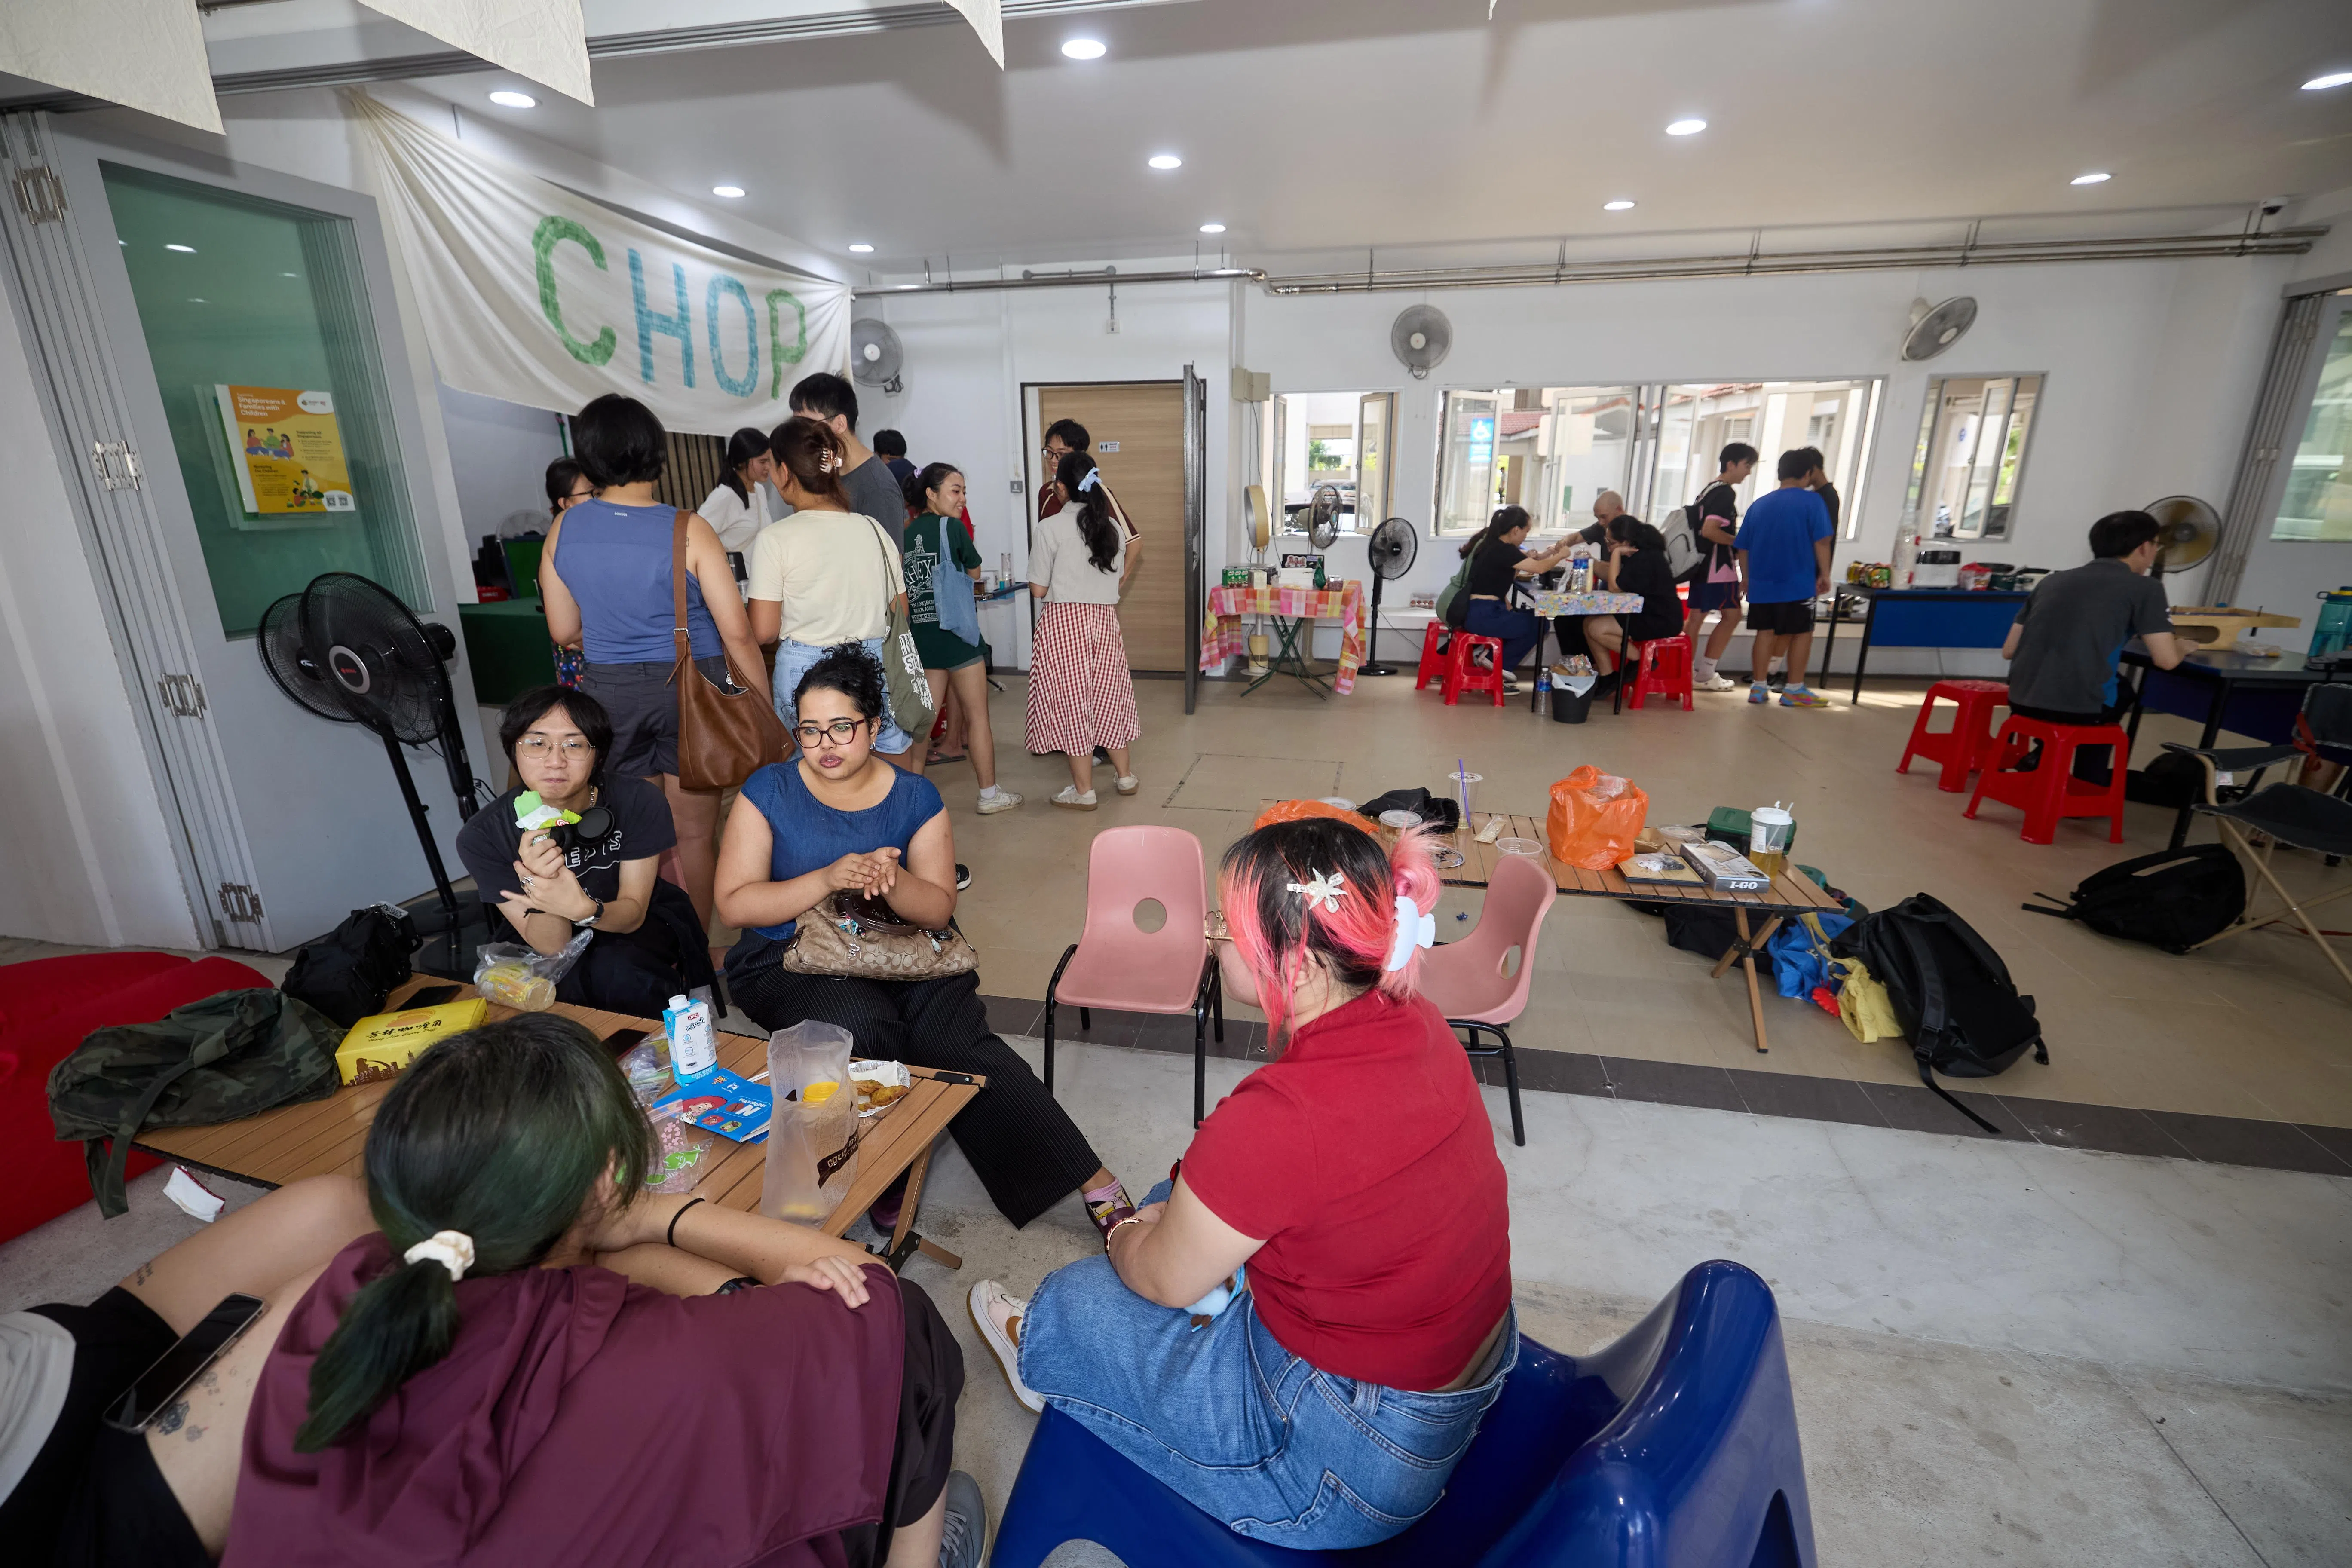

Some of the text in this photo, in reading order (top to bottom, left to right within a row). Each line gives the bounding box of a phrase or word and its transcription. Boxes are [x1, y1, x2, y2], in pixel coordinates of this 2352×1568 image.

[532, 215, 808, 400] CHOP
[238, 396, 279, 405] Singaporeans
[1730, 881, 1758, 889] I-GO
[691, 1065, 714, 1078] COCONUT
[695, 1069, 712, 1079] WATER
